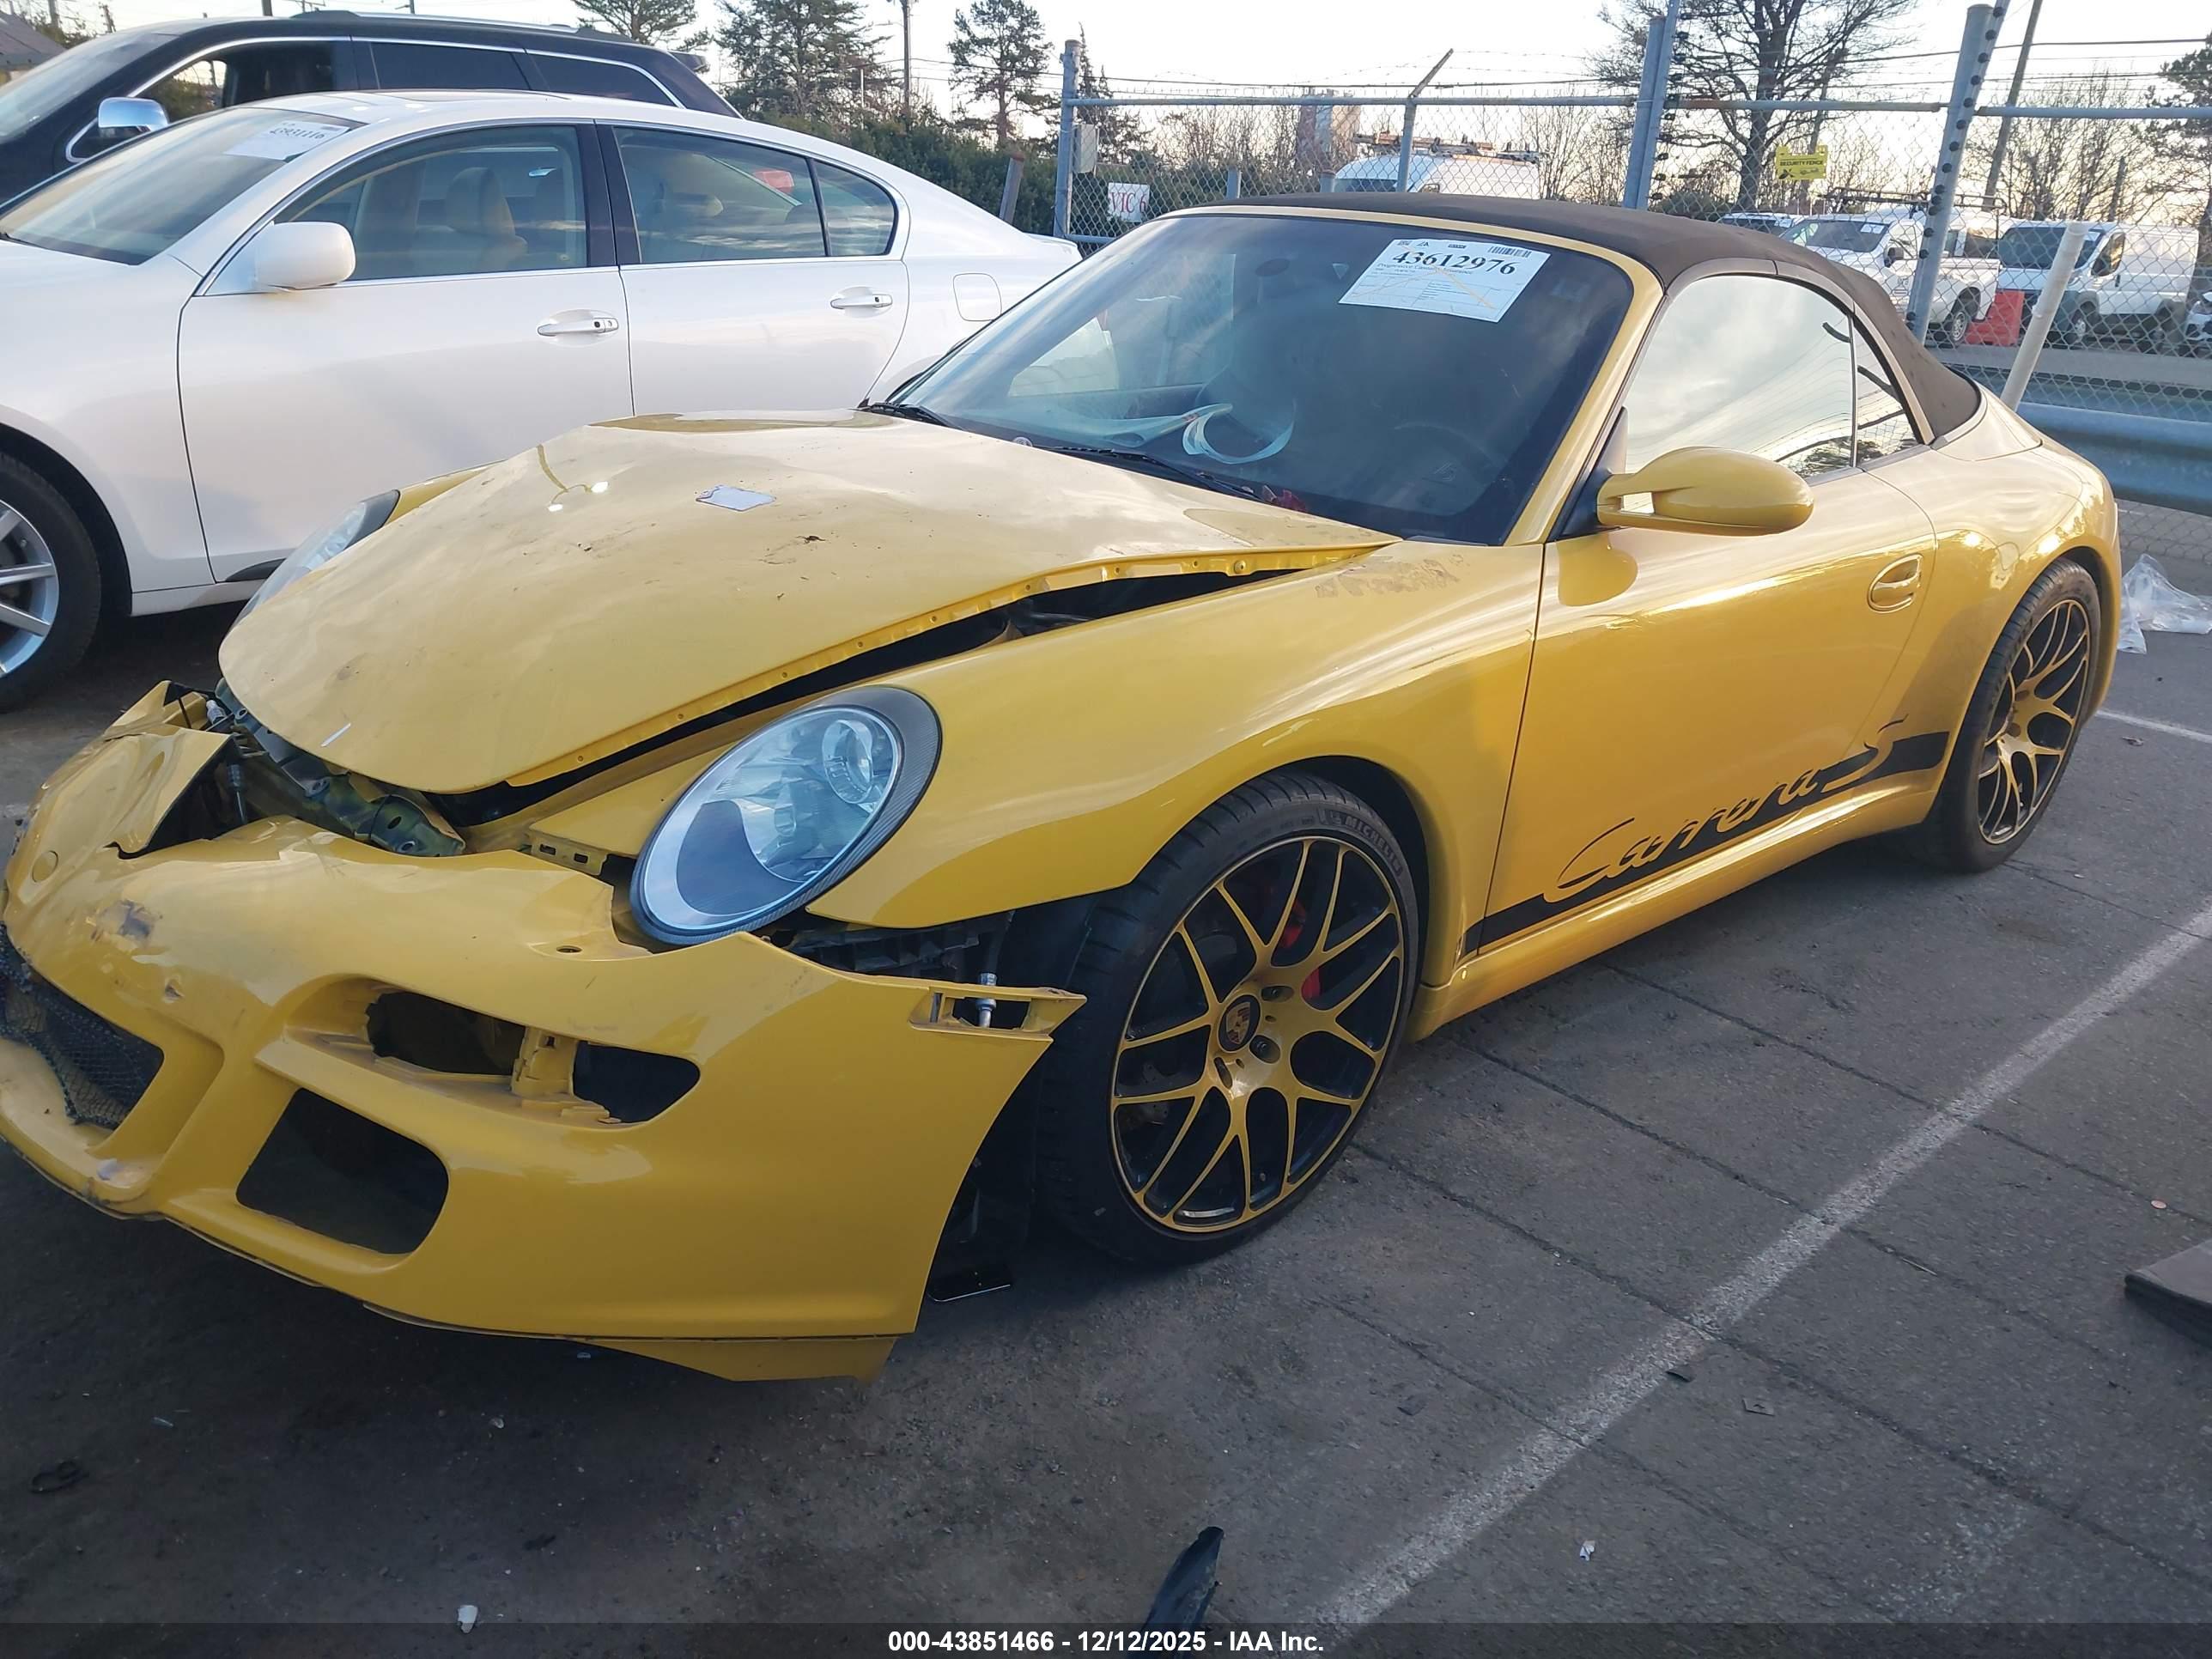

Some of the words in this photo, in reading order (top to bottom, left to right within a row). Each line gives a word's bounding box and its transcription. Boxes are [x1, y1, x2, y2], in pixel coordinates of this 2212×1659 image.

[1392, 250, 1517, 276] 43612976
[1543, 763, 1820, 903] Carrera
[1820, 714, 1910, 793] S
